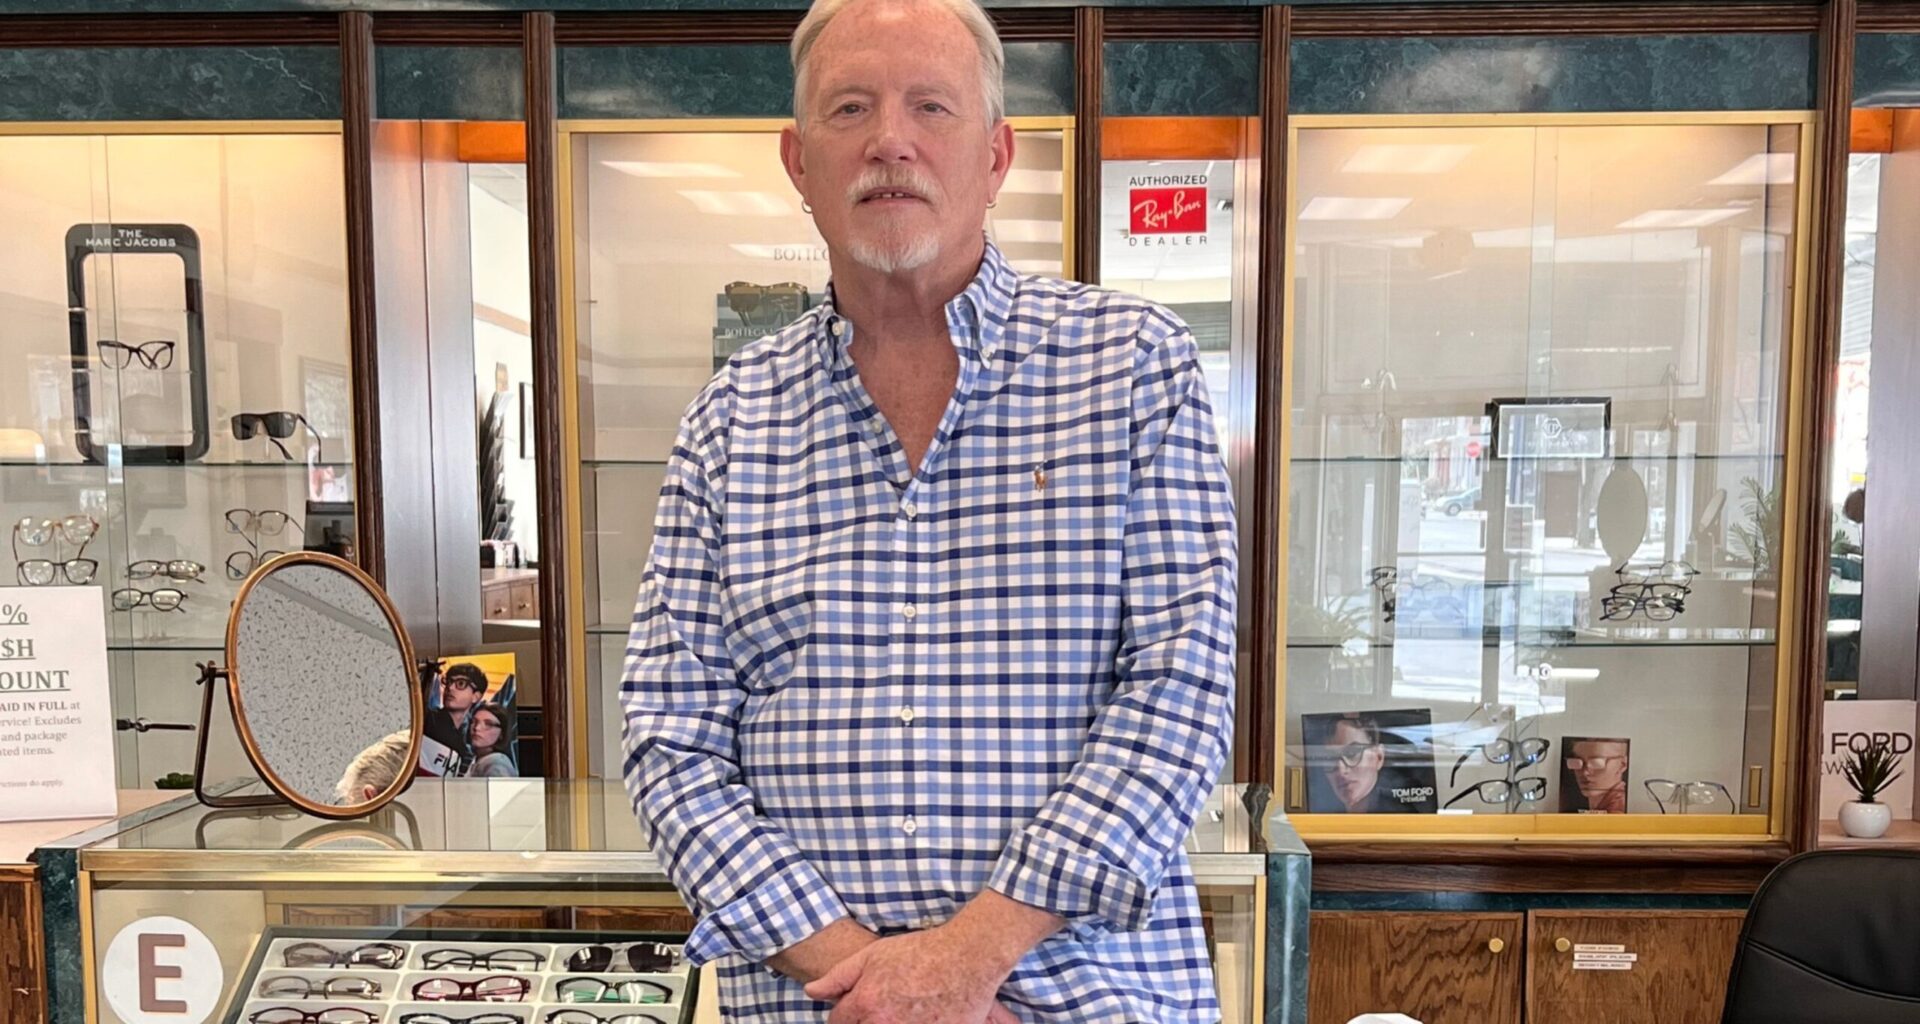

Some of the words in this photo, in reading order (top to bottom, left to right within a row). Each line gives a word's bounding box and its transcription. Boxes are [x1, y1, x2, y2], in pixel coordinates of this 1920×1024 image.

[1129, 175, 1208, 186] AUTHORIZED
[118, 229, 143, 237] THE
[85, 238, 121, 247] MARC
[124, 238, 176, 247] JACOBS
[1129, 235, 1208, 247] DEALER
[23, 702, 36, 711] IN
[39, 701, 68, 711] FULL
[70, 702, 81, 710] at
[34, 715, 82, 726] Excludes
[1, 731, 21, 741] and
[24, 730, 67, 743] package
[1831, 732, 1913, 755] FORD
[434, 753, 458, 775] FILA
[1391, 788, 1410, 798] TOM
[1411, 787, 1433, 796] FORD
[138, 933, 188, 1014] E
